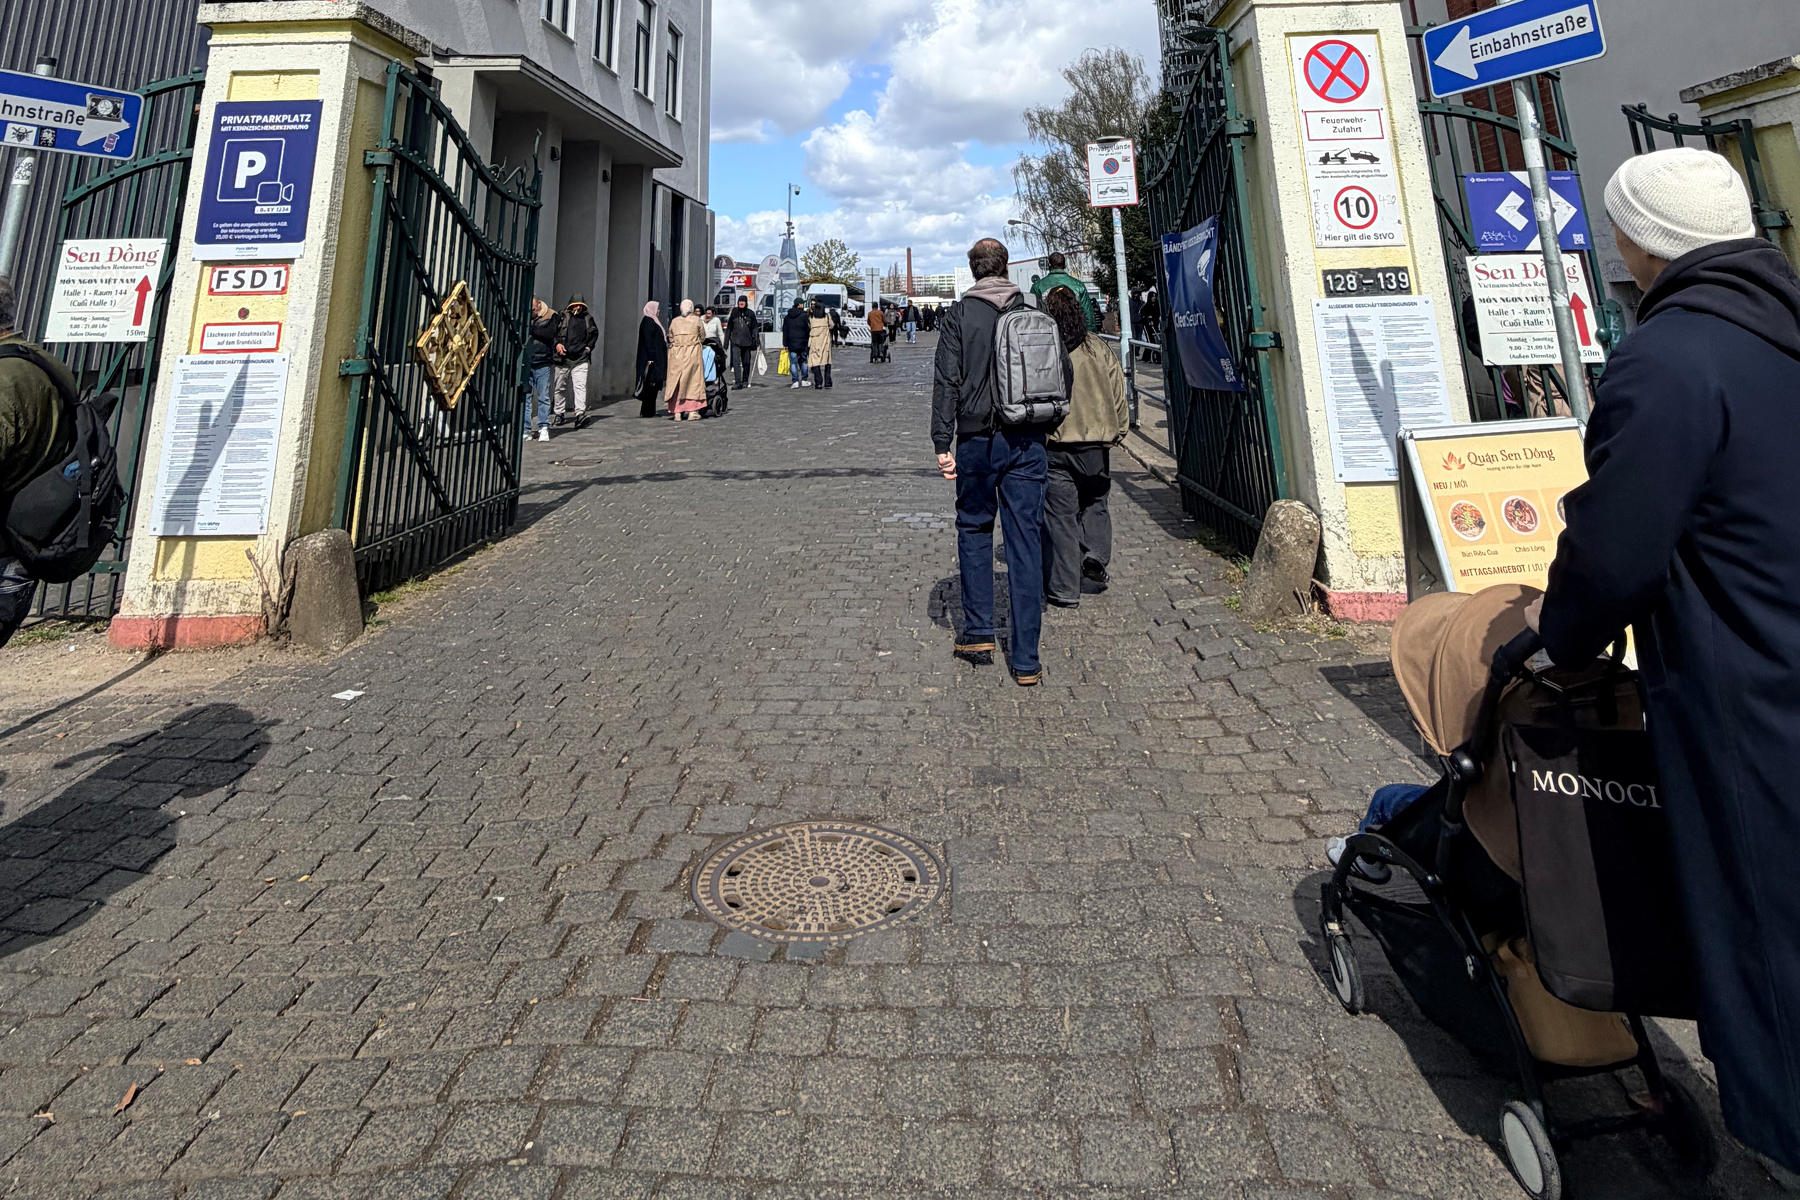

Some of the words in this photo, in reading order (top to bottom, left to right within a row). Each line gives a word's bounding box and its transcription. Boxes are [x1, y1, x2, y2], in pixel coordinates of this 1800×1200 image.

[1469, 15, 1588, 59] Einbahnstraße
[2, 99, 85, 126] hnstraße
[221, 113, 312, 125] PRIVATPARKPLATZ
[1320, 116, 1367, 125] Feuerwehr-
[1332, 126, 1363, 134] Zufahrt
[234, 151, 267, 189] P
[1340, 196, 1370, 218] 10
[1324, 233, 1342, 241] Hier
[1343, 233, 1357, 242] gilt
[1358, 233, 1372, 241] die
[1373, 232, 1395, 240] StVO
[65, 246, 101, 264] Sen
[105, 243, 160, 267] Đồng
[1474, 262, 1516, 281] Sen
[1520, 258, 1580, 283] Đg
[89, 299, 107, 307] Halle
[1523, 319, 1544, 327] Halle
[1580, 349, 1600, 357] 50m
[1500, 449, 1522, 463] Sen
[1433, 481, 1448, 490] NEU
[1459, 564, 1526, 577] MITTAGSANGEBOT
